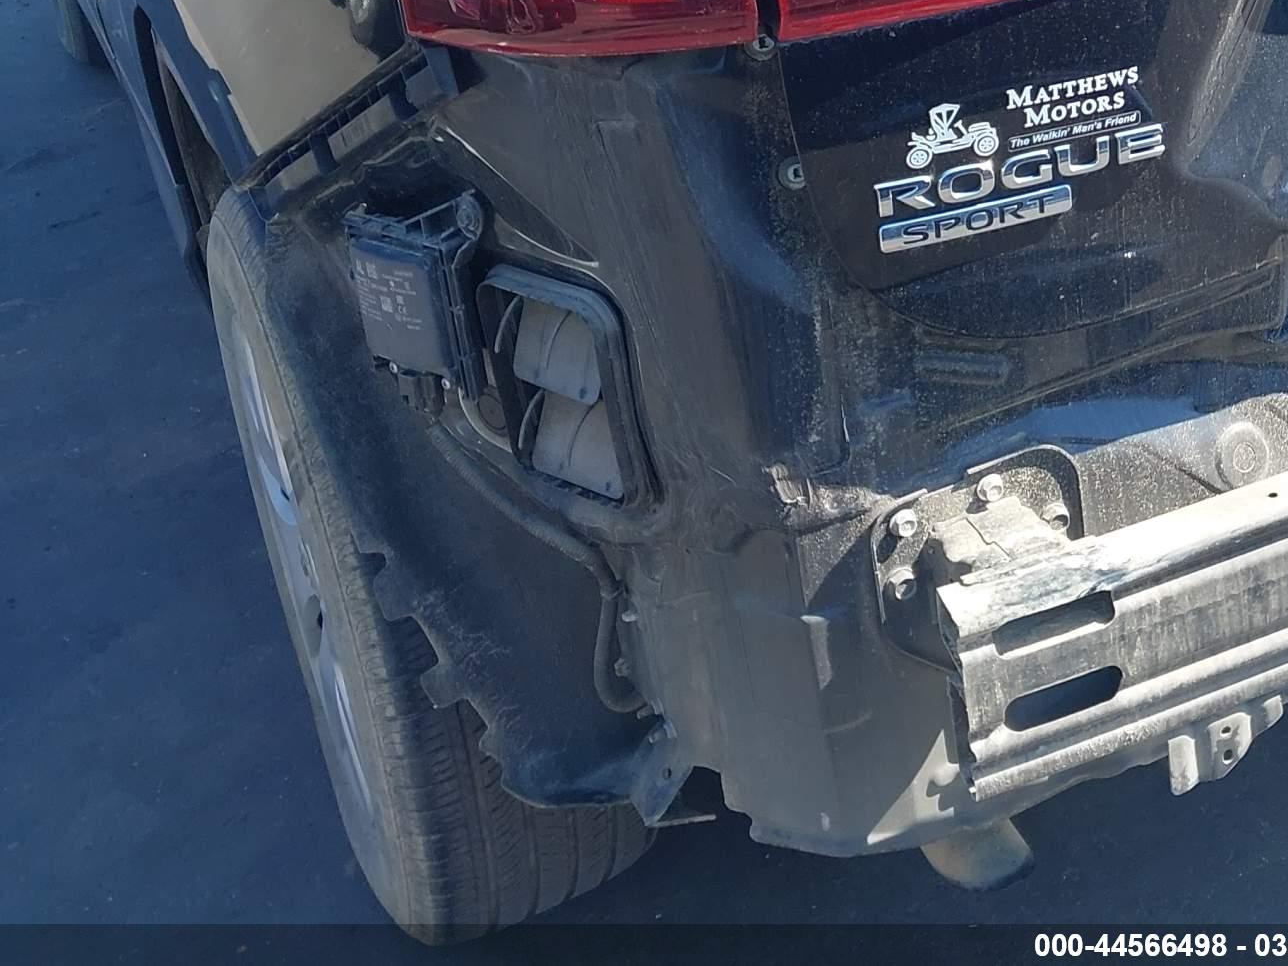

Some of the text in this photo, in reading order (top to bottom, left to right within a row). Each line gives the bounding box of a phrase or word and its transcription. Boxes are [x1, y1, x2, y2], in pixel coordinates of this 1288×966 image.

[1005, 65, 1139, 110] MATTHEWS
[1023, 91, 1125, 128] MOTORS
[1010, 112, 1137, 149] The Walkin' Man's Friend
[873, 123, 1166, 218] ROGUE
[902, 193, 1055, 245] SPORT
